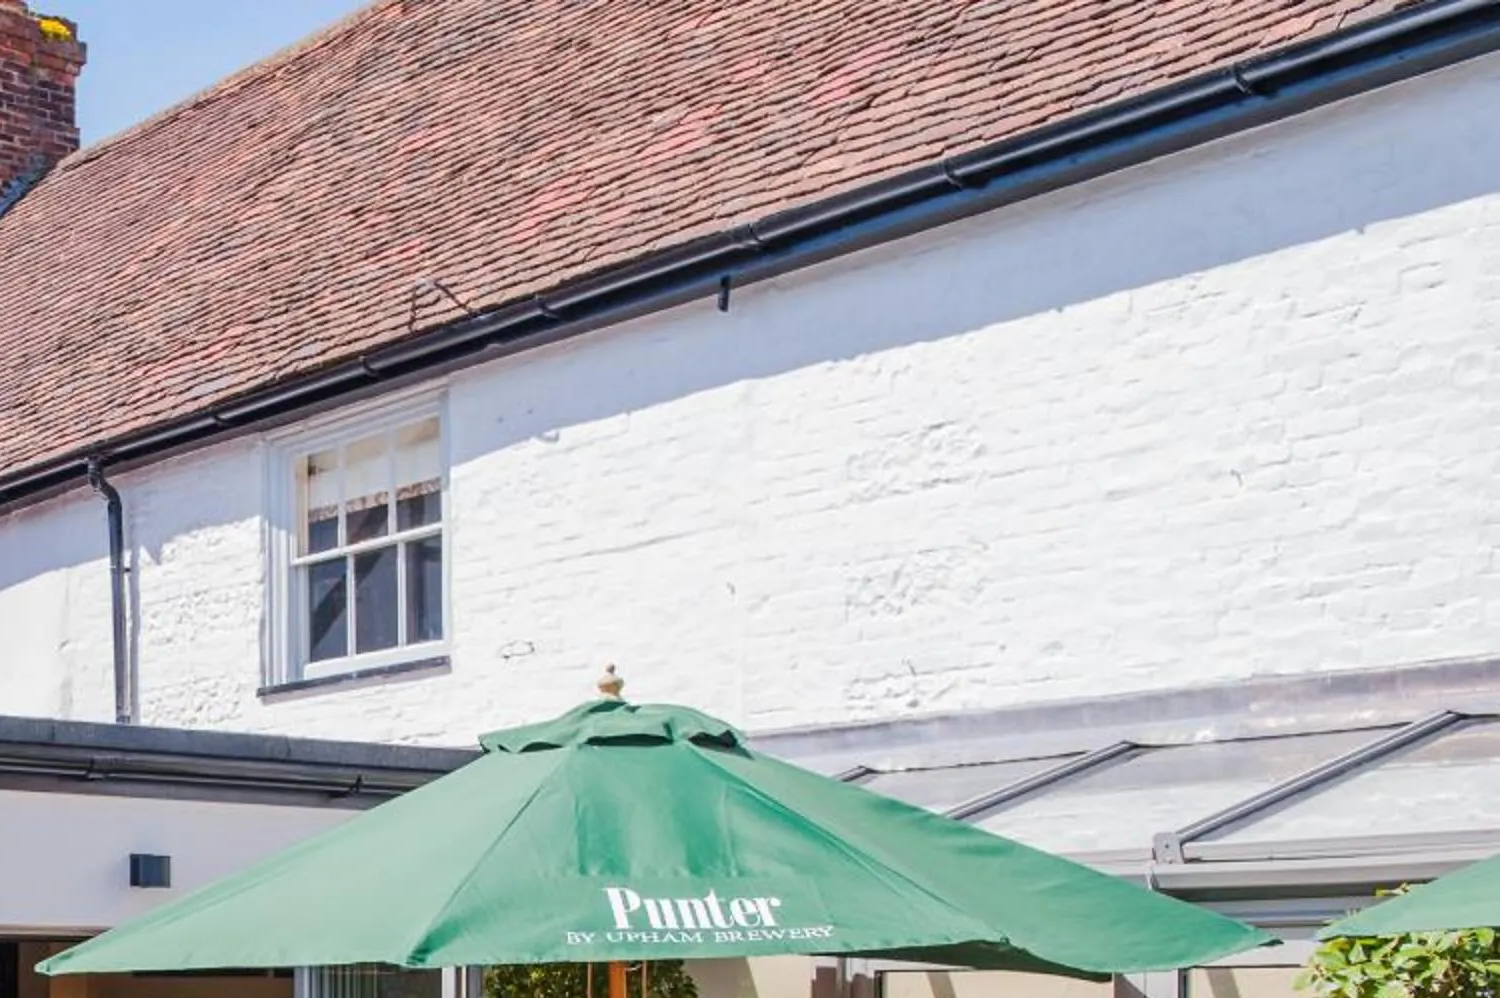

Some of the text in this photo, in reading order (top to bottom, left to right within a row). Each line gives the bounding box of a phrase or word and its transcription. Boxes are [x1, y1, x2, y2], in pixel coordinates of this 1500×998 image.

[600, 887, 781, 929] Punter
[566, 924, 836, 944] BY UPHAM BREWERY
